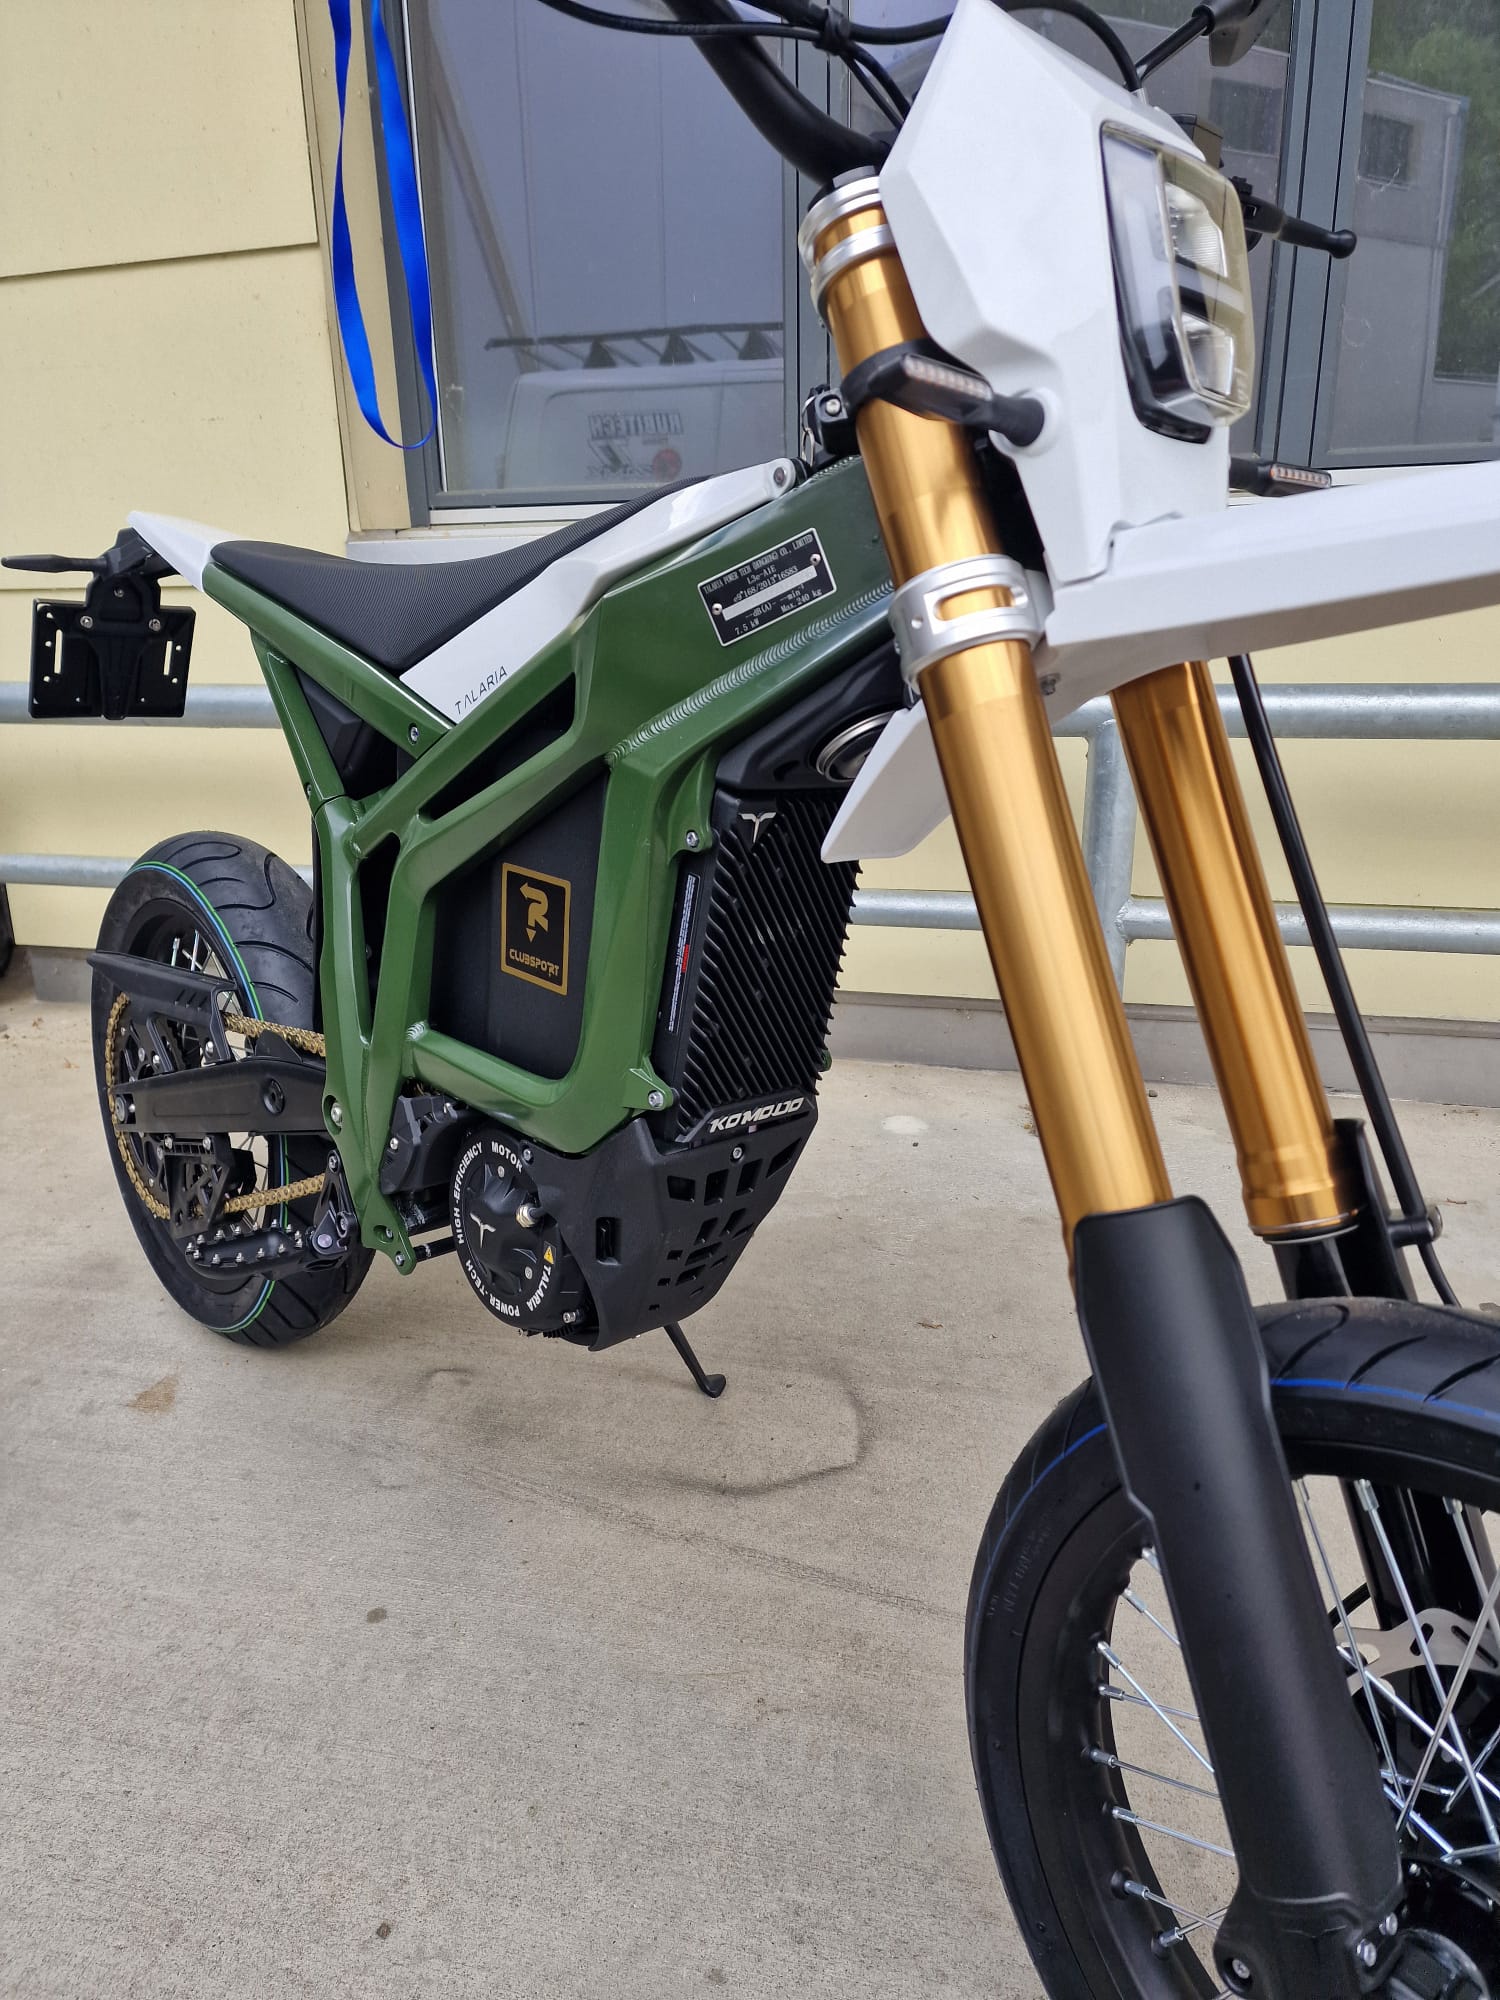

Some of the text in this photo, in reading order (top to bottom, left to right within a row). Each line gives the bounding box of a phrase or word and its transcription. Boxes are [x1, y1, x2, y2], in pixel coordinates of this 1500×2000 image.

[734, 624, 749, 635] 7.5
[455, 665, 508, 714] TALARIA
[509, 948, 560, 977] CLUBSPORT
[709, 1097, 805, 1133] KOMODO
[491, 1141, 524, 1173] MOTOR
[527, 1264, 552, 1312] TALARIA
